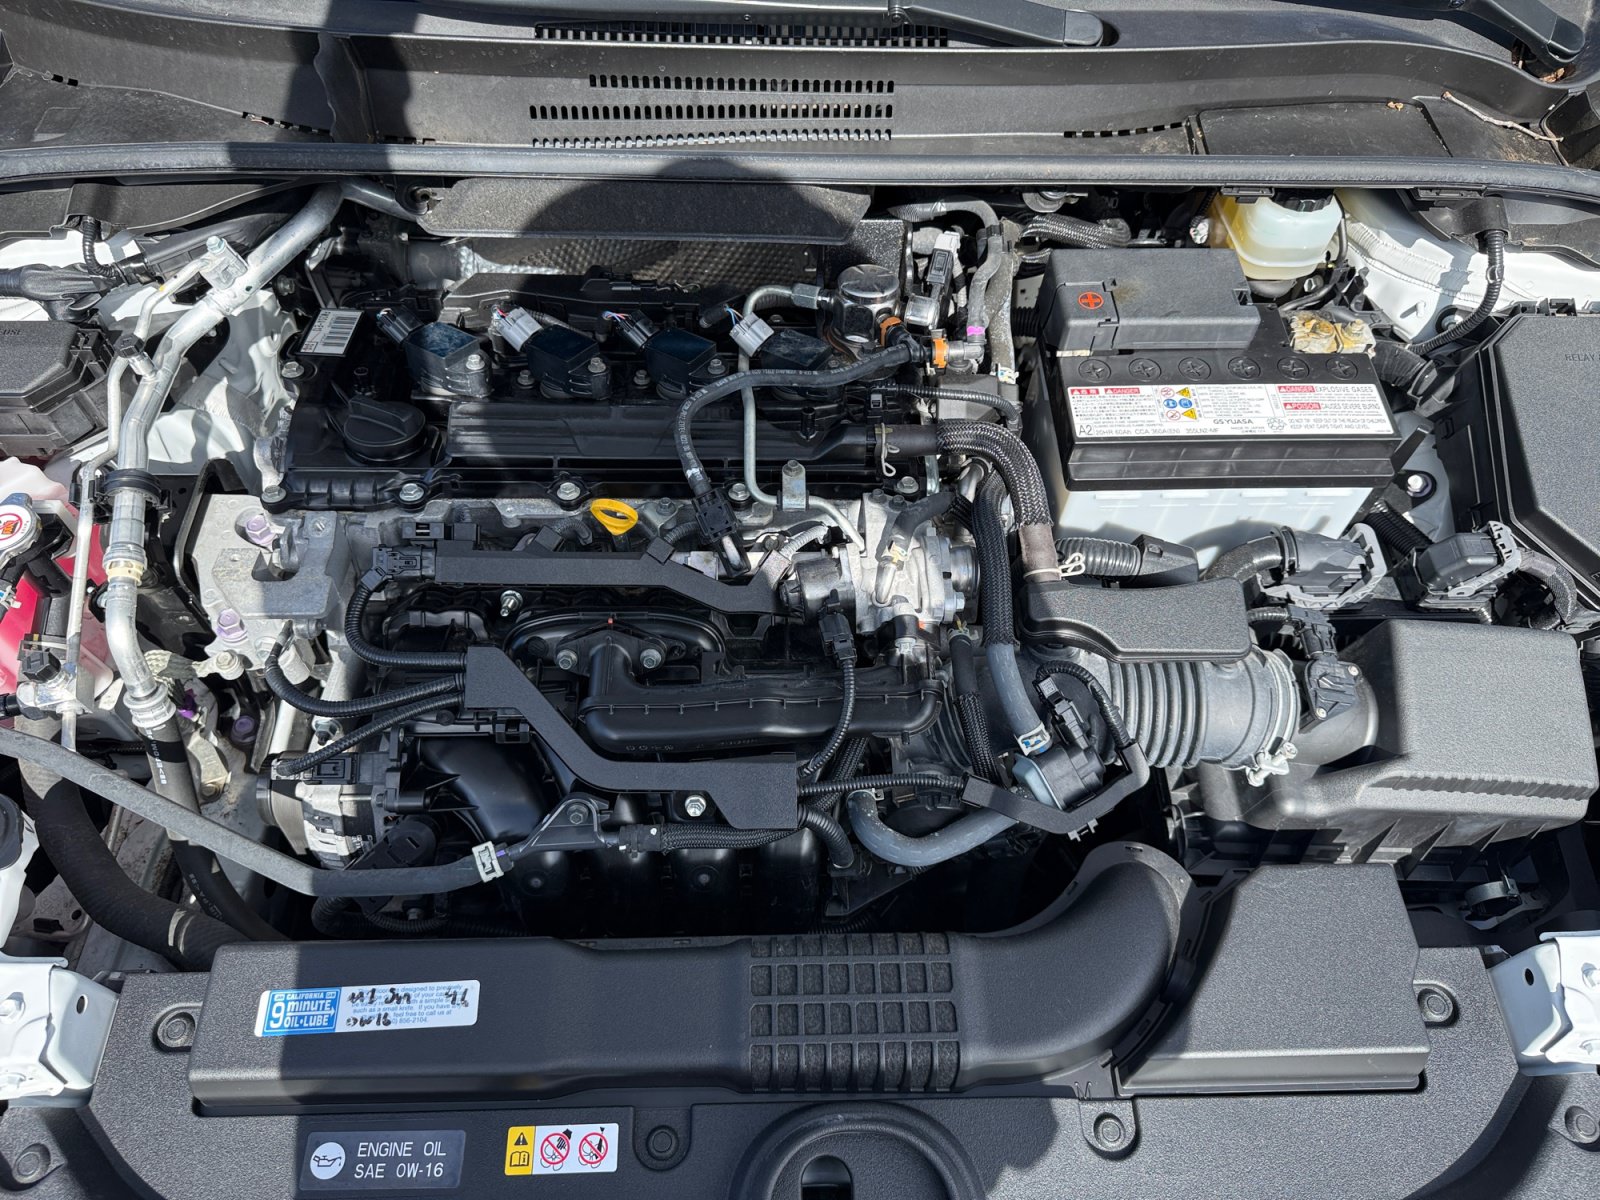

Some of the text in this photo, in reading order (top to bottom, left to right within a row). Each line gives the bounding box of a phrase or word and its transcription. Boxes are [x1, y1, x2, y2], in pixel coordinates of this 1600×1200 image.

[1078, 424, 1093, 436] A2
[286, 992, 324, 1000] CALIFORNIA
[270, 1001, 285, 1029] 9
[357, 1141, 446, 1157] ENGINE OIL
[354, 1162, 444, 1179] SAE 0W-16
